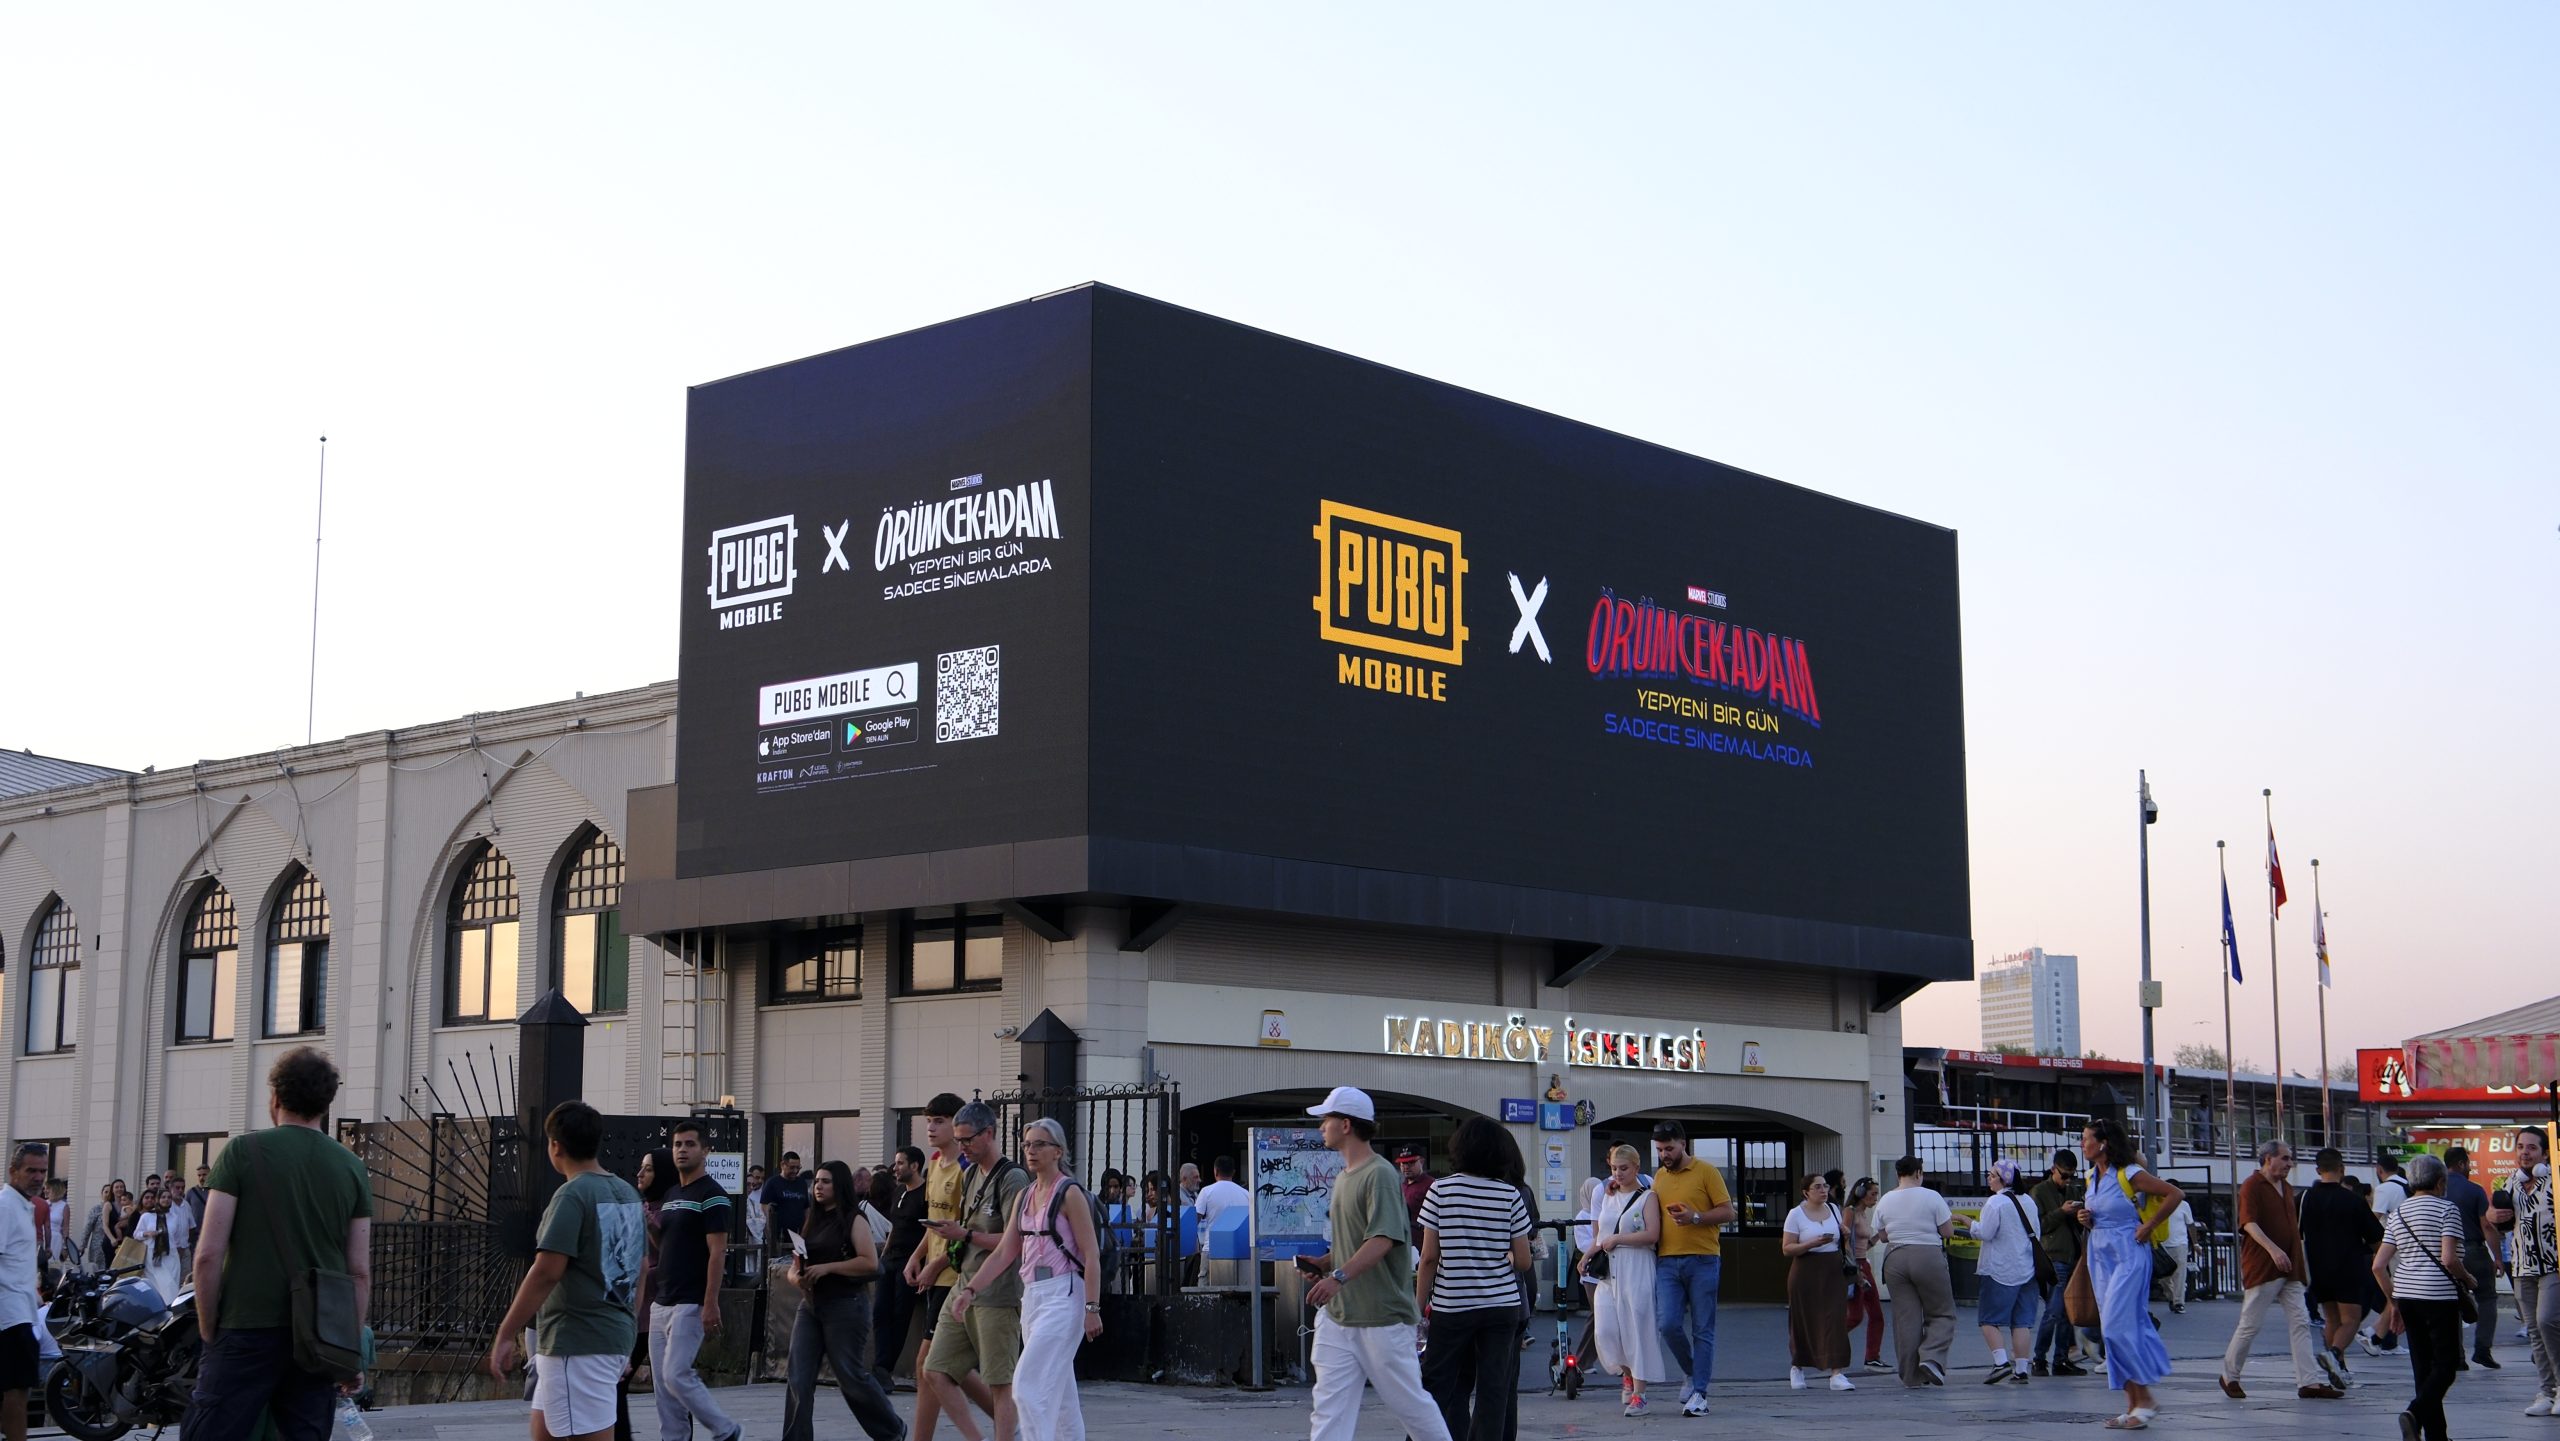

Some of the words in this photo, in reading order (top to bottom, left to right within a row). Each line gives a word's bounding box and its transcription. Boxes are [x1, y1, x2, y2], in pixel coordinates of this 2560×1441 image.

[874, 479, 1060, 571] ÖRÜMCEK-ADAM
[721, 531, 784, 593] PUBG
[883, 576, 940, 601] SADECE
[943, 557, 1052, 588] SİNEMALARDA
[908, 549, 965, 576] YEPYENİ
[968, 546, 992, 565] BİR
[995, 541, 1023, 559] GÜN
[1339, 530, 1446, 637] PUBG
[720, 602, 783, 630] MOBILE
[1507, 571, 1552, 664] X
[1339, 654, 1447, 702] MOBILE
[1586, 586, 1822, 729] ÖRÜMCEK-ADAM
[774, 688, 812, 715] PUBG
[818, 678, 870, 707] MOBILE
[1637, 689, 1708, 720] YEPYENİ
[1714, 702, 1741, 728] BİR
[1746, 706, 1779, 734] GÜN
[772, 735, 790, 748] App
[791, 729, 831, 744] Store'dan
[865, 718, 894, 733] Google
[894, 716, 911, 729] Play
[1604, 713, 1680, 747] SADECE
[1684, 726, 1813, 768] SİNEMALARDA
[757, 769, 793, 783] KRAFTON
[1384, 1015, 1553, 1062] KADIKÖY
[1565, 1016, 1707, 1072] İSKELESİ
[704, 1159, 719, 1167] olcu
